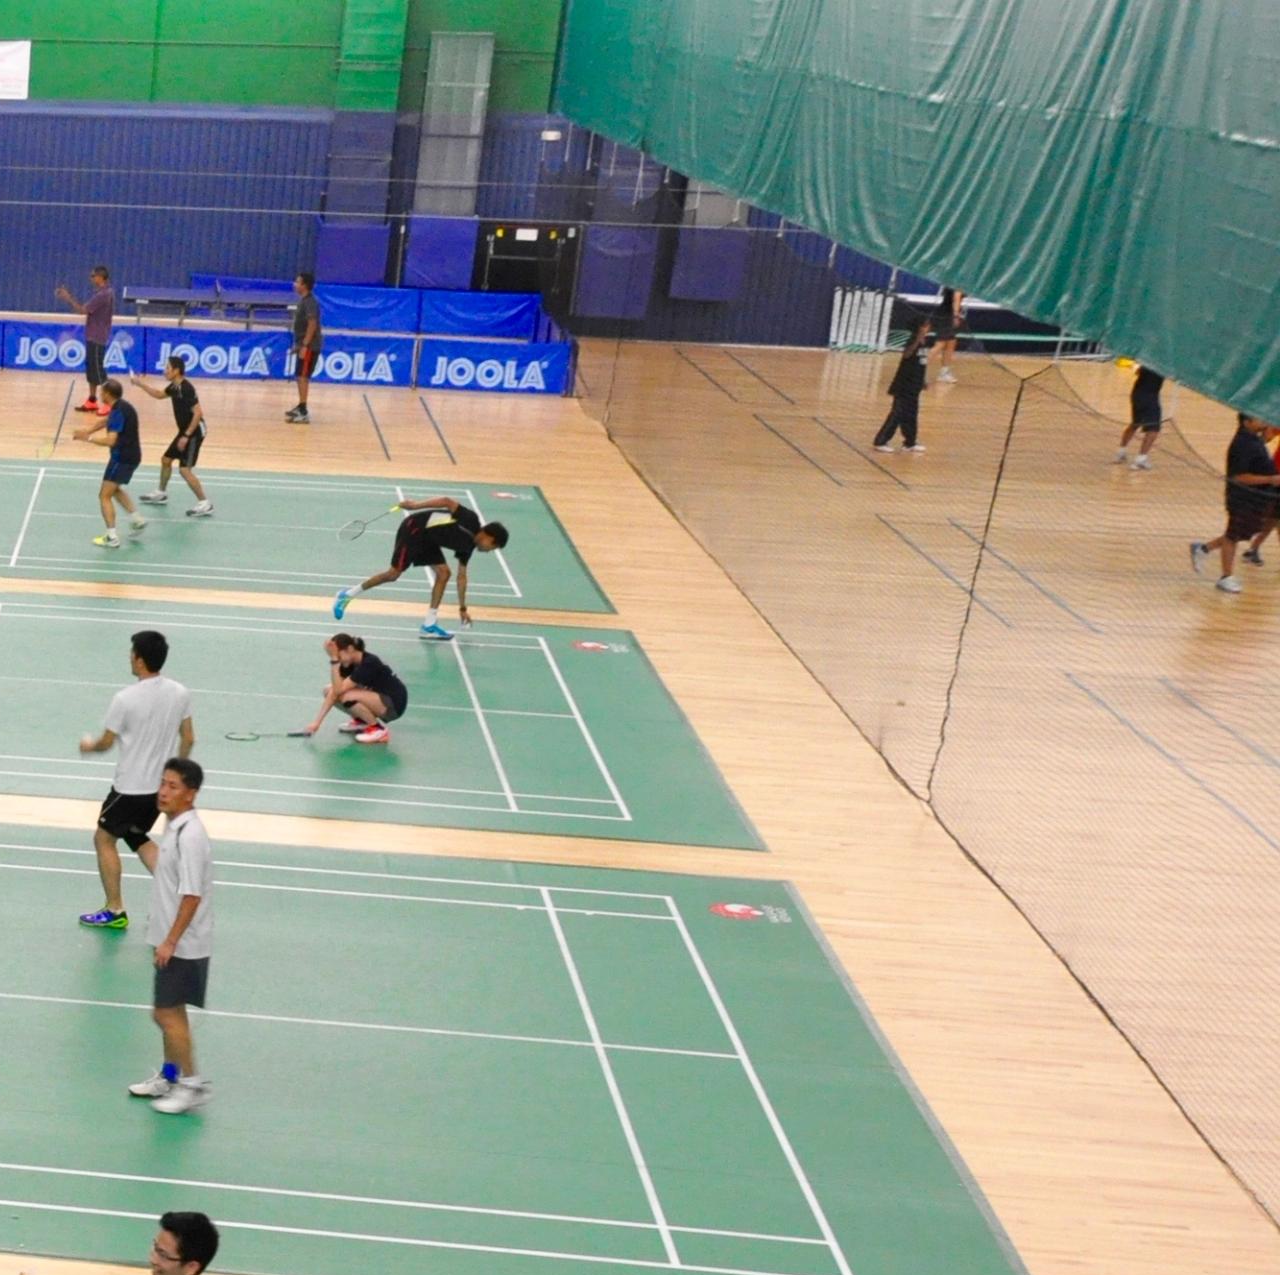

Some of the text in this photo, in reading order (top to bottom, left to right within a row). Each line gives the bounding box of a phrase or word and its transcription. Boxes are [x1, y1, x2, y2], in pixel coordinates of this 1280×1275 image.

[15, 336, 128, 368] JOOA
[284, 348, 394, 382] JOLA
[431, 356, 546, 390] JOOLA
